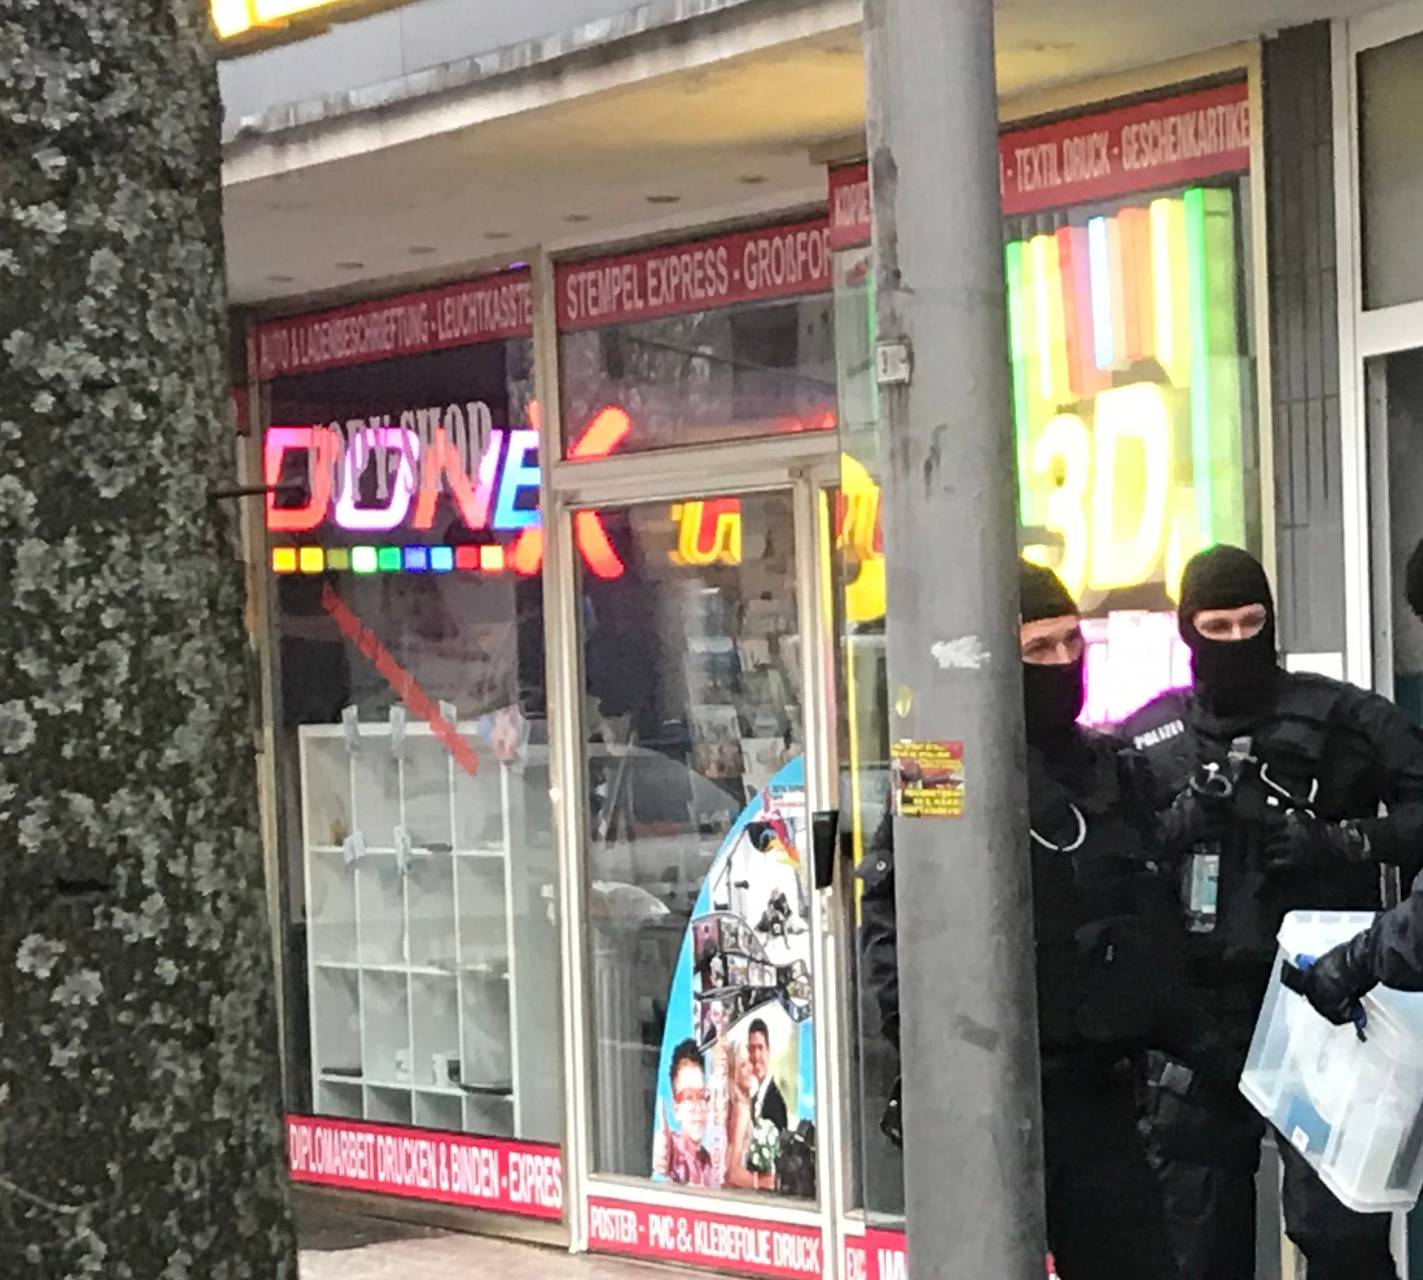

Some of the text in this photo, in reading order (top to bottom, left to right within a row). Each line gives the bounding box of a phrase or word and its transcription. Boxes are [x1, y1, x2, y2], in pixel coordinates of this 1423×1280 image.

[1014, 144, 1062, 193] TEXTIL
[1063, 131, 1111, 183] DRUCK
[1121, 101, 1249, 171] GESCHENKARTIKE
[566, 263, 644, 320] STEMPEL
[647, 245, 728, 307] EXPRESS
[1133, 719, 1185, 750] POLIZEI
[289, 1123, 375, 1181] DIPLOMARBEIT
[377, 1134, 437, 1189] DRUCKEN
[438, 1142, 450, 1192] &
[451, 1144, 499, 1198] BINDEN
[508, 1151, 562, 1209] EXPRES
[590, 1205, 638, 1244] POSTER
[648, 1213, 675, 1250] PVC
[677, 1217, 692, 1252] &
[693, 1219, 771, 1265] KLEBEFOLIE
[772, 1231, 820, 1273] DRUCK
